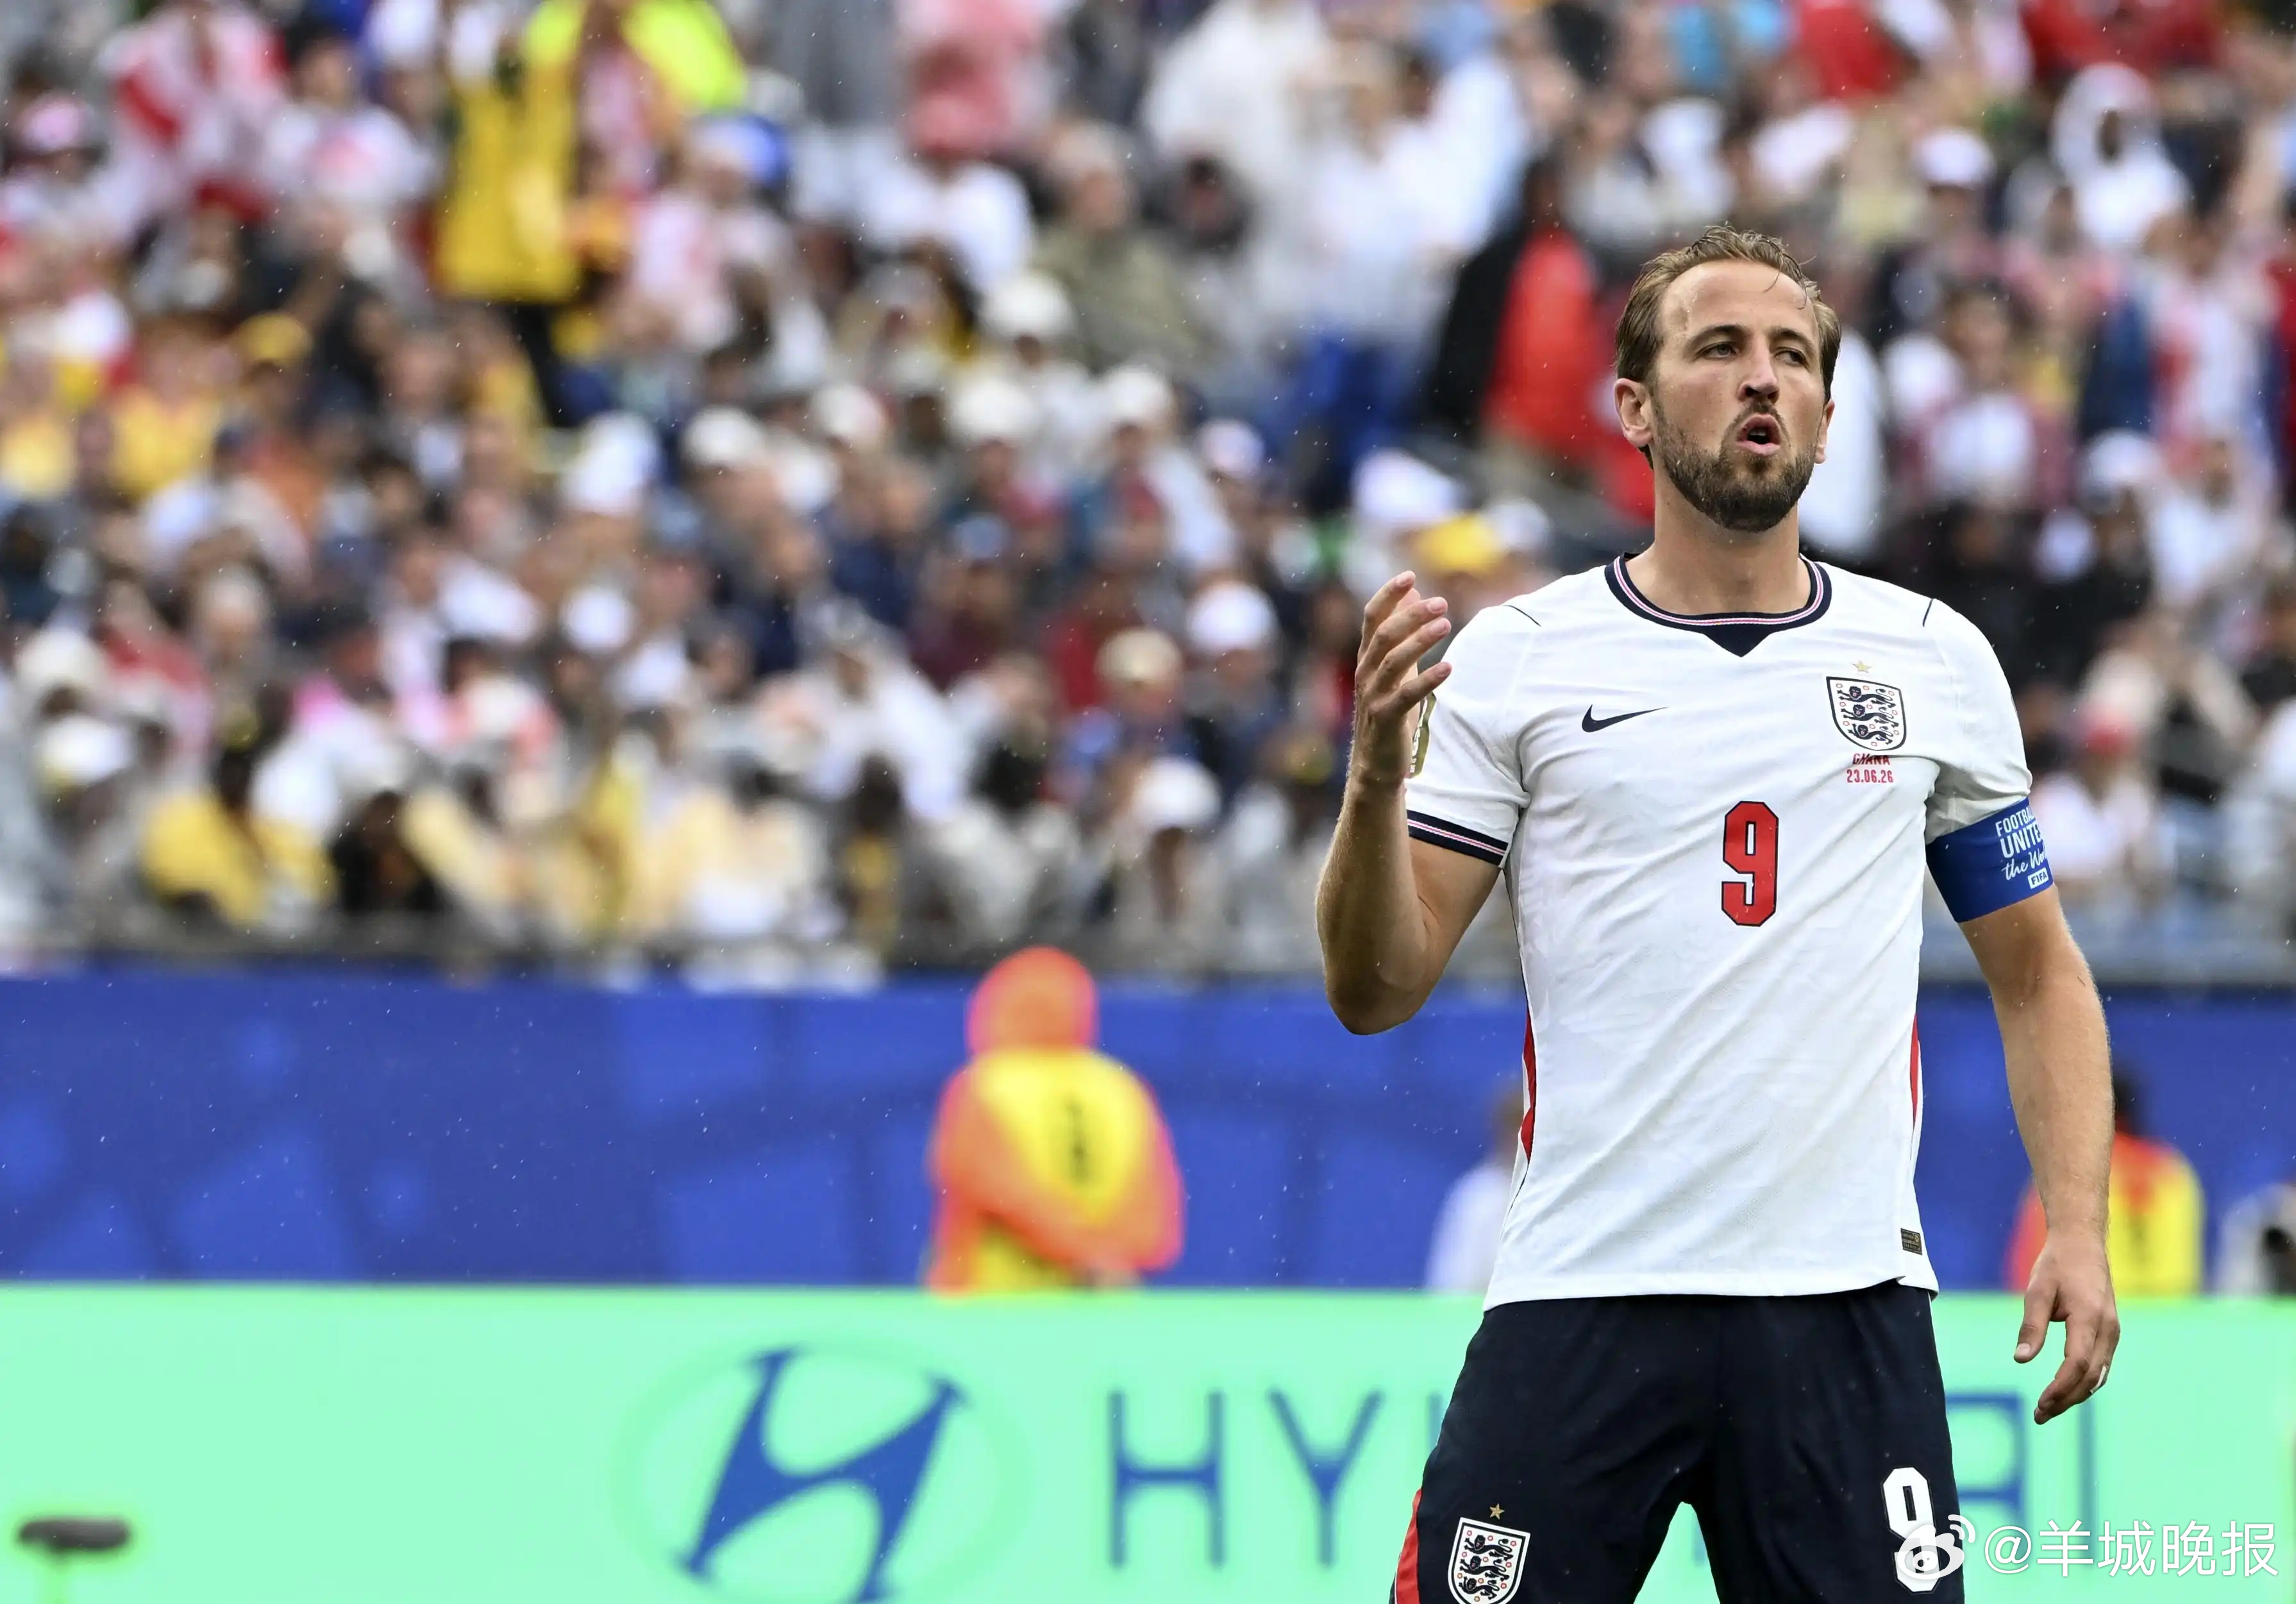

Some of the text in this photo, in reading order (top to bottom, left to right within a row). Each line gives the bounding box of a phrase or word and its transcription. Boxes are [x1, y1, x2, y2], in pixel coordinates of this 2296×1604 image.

[1852, 753, 1890, 765] GHANA
[1847, 769, 1894, 783] 23.06.26
[1722, 800, 1779, 927] 9
[2000, 858, 2029, 881] the
[2031, 870, 2047, 886] FIFA
[1882, 1466, 1941, 1594] 9
